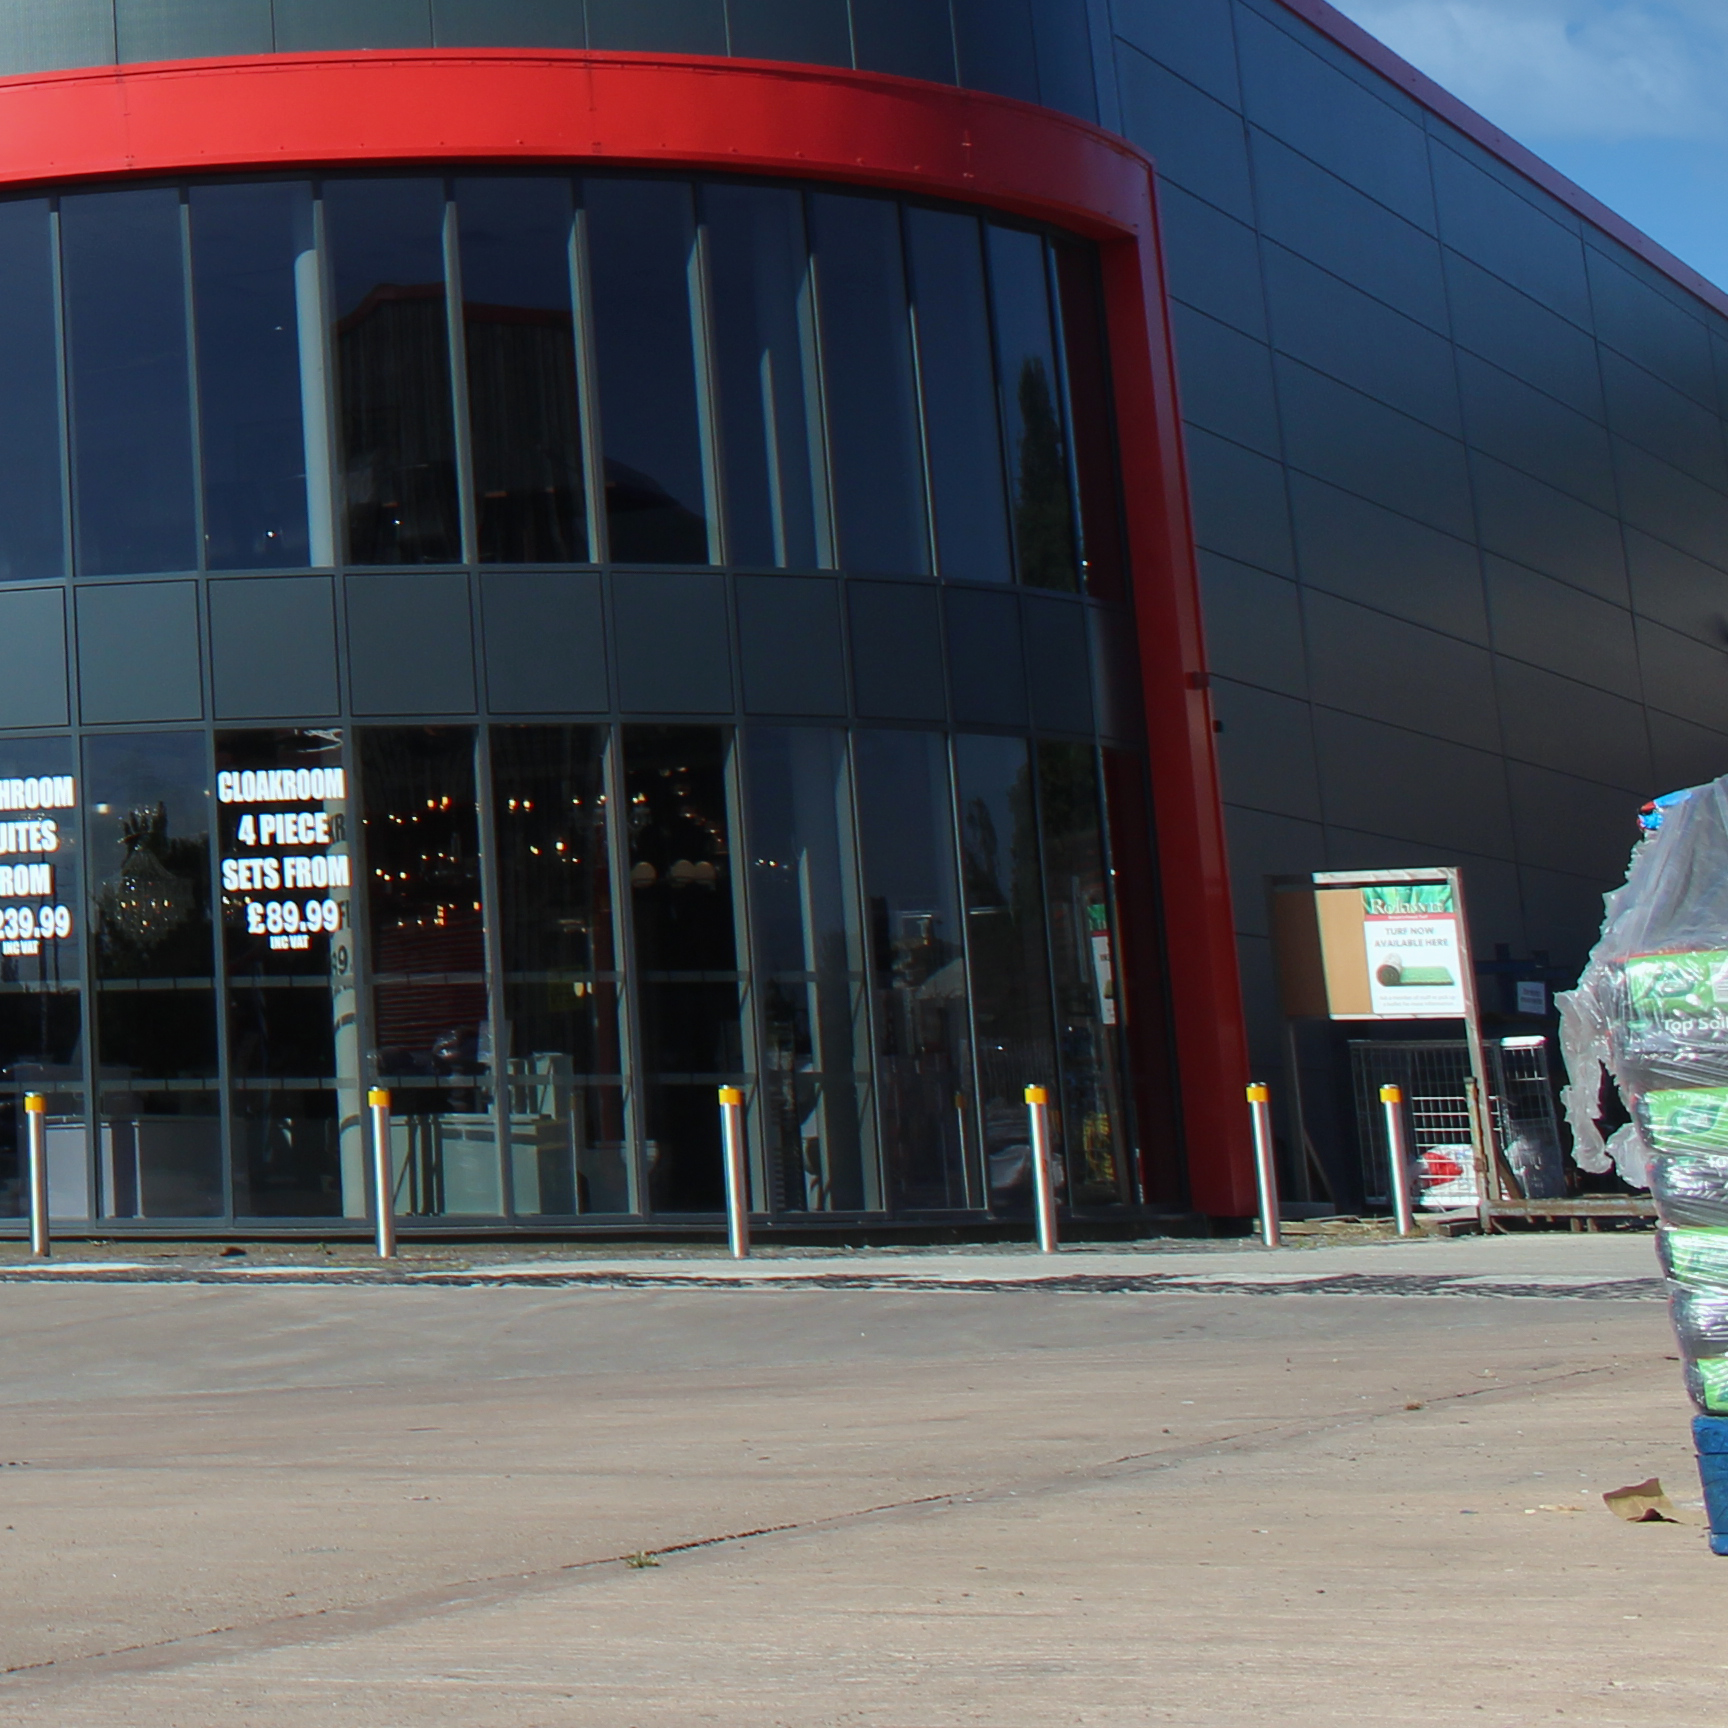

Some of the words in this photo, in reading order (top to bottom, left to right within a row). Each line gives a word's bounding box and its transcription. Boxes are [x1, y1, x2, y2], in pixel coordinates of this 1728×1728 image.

[217, 768, 347, 803] CLOAKROOM
[238, 814, 256, 846] 4
[259, 812, 330, 845] PIECE
[222, 857, 281, 891] SETS
[283, 854, 351, 889] FROM
[247, 898, 339, 934] £89.99
[1385, 927, 1408, 935] TURF
[1410, 927, 1434, 935] NOW
[2, 941, 21, 956] INC
[20, 940, 40, 955] VAT
[270, 935, 289, 950] INC
[289, 935, 310, 949] VAT
[1374, 939, 1423, 947] AVAILABLE
[1425, 938, 1448, 946] HERE
[1665, 1020, 1694, 1036] Top
